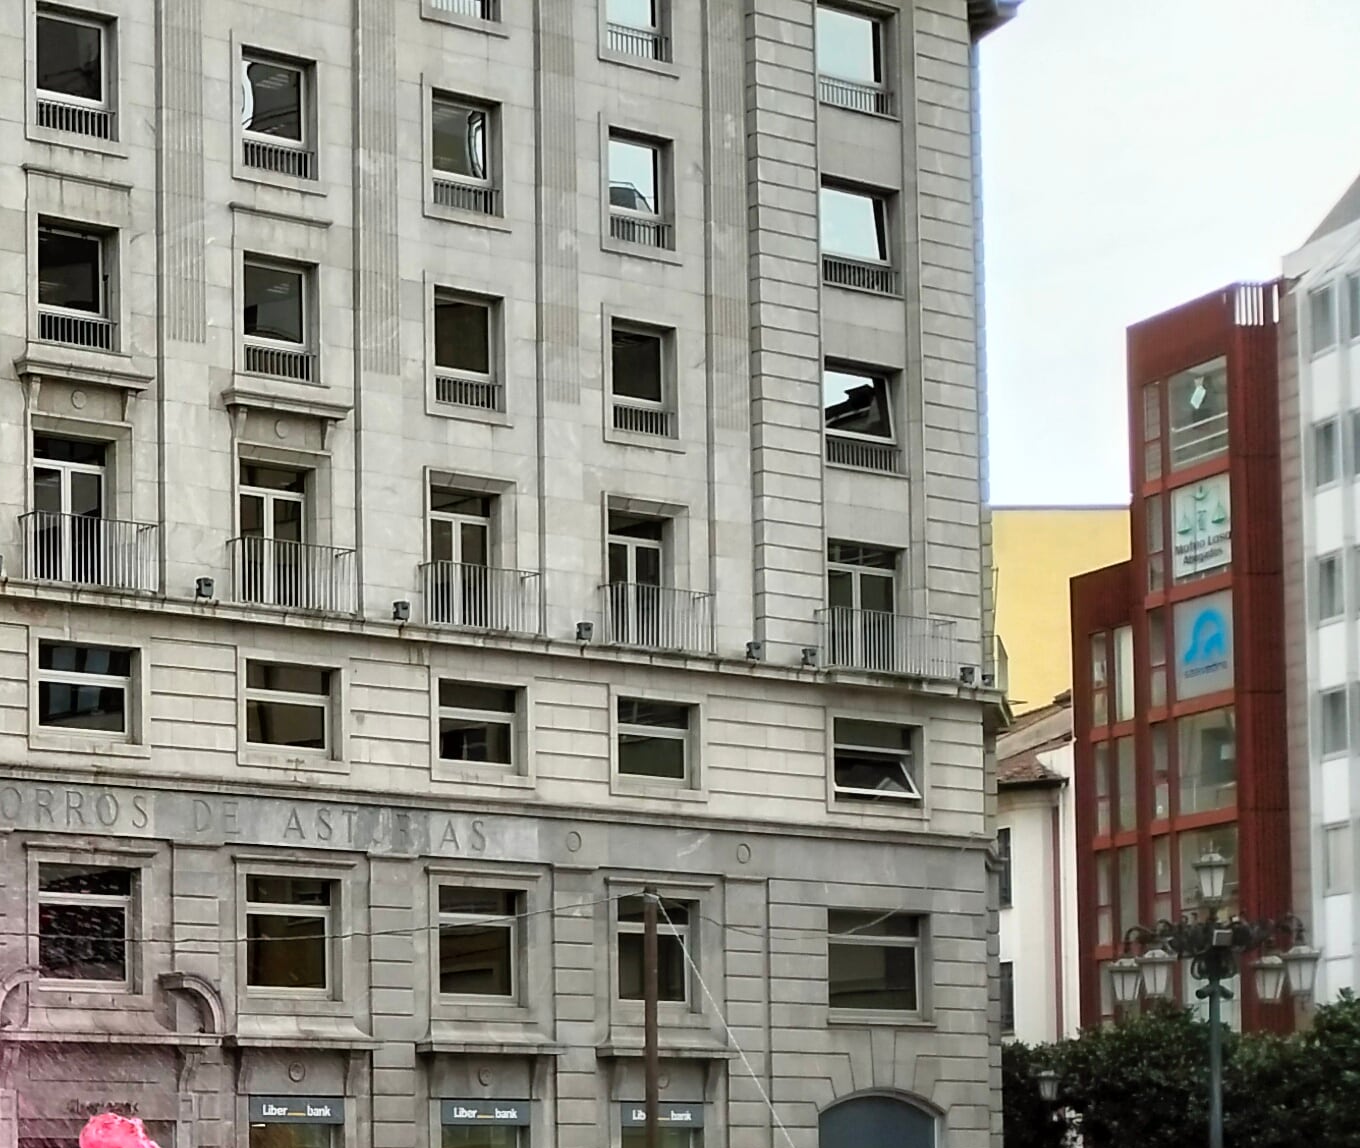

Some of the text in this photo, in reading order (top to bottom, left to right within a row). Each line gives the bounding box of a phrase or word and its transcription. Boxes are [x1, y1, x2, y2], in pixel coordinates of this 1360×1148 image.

[192, 799, 242, 835] DE
[262, 1104, 331, 1116] Liber bank
[453, 1107, 518, 1119] Liber bank
[632, 1109, 647, 1121] Lib
